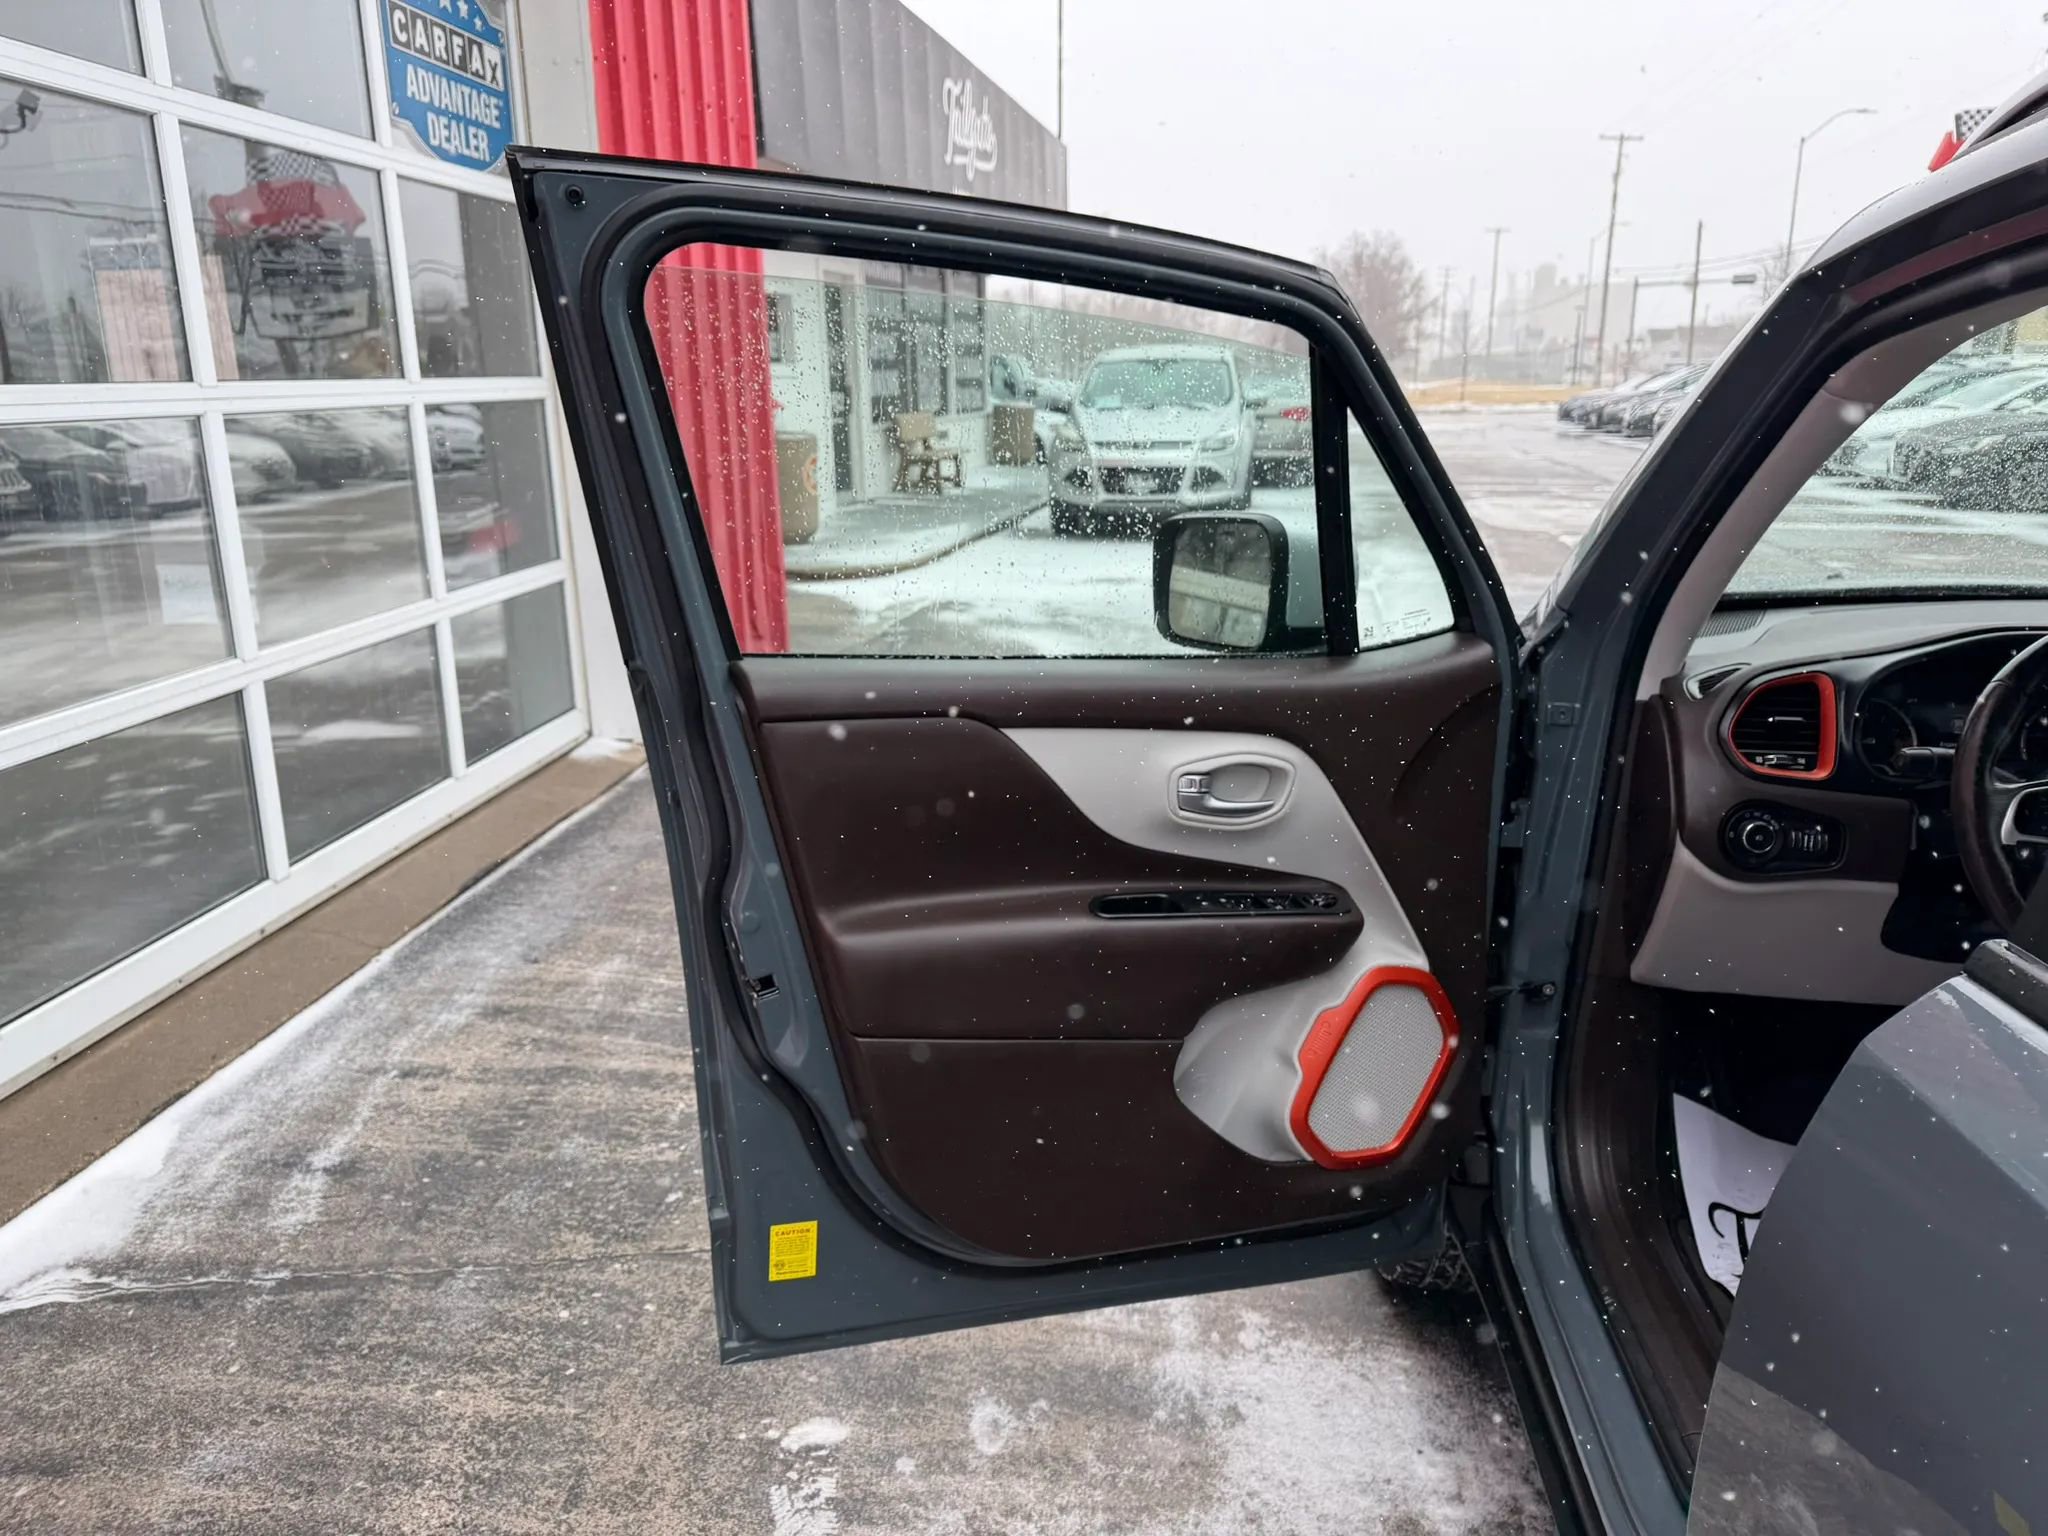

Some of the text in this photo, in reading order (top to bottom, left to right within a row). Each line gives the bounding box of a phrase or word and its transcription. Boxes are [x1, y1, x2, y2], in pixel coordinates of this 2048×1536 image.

[392, 8, 501, 88] CARFAX
[406, 63, 502, 129] ADVANTAGE
[426, 110, 490, 162] DEALER
[775, 1227, 811, 1237] CAUTION
